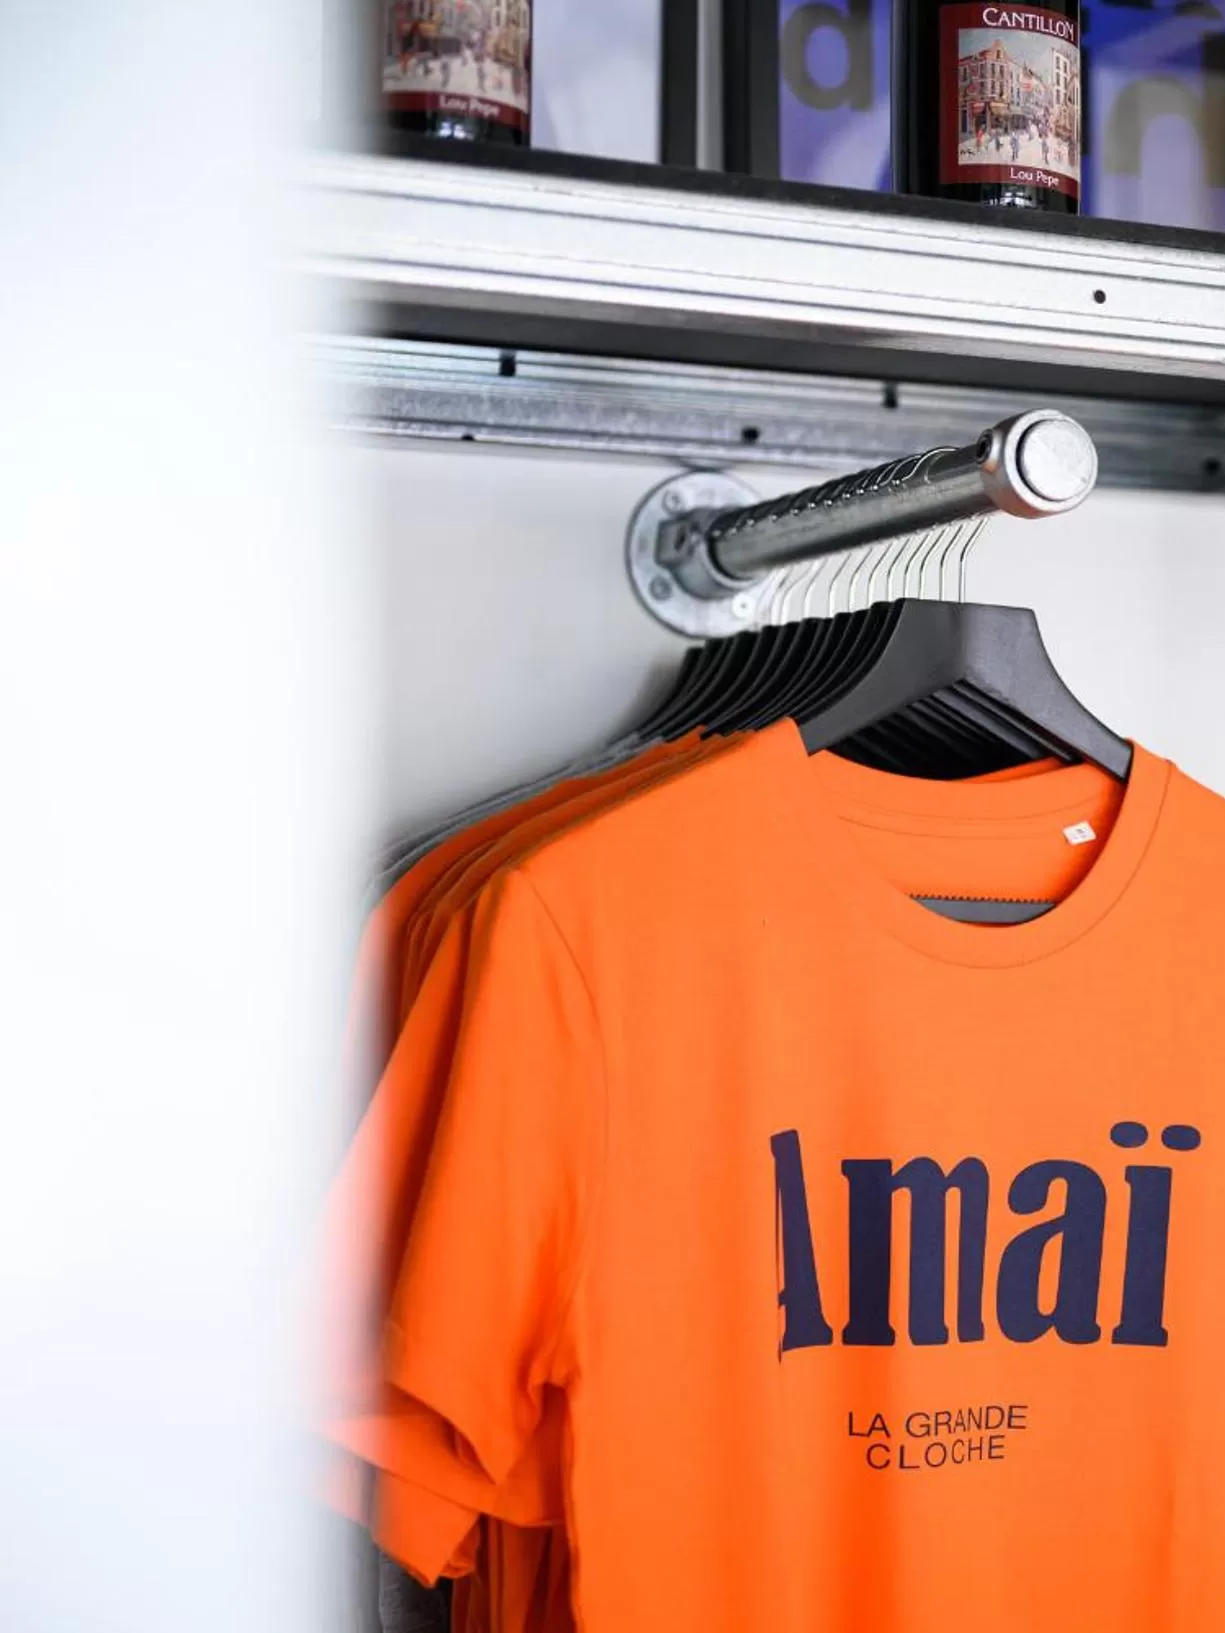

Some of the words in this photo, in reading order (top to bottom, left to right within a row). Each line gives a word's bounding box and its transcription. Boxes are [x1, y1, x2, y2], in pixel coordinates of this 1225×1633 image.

[982, 7, 1074, 41] CANTILLON
[1010, 167, 1033, 181] Lou
[1036, 171, 1059, 188] Pepe
[848, 1411, 891, 1437] LA
[905, 1405, 1029, 1438] GRANDE
[866, 1435, 1006, 1470] CLOCHE
